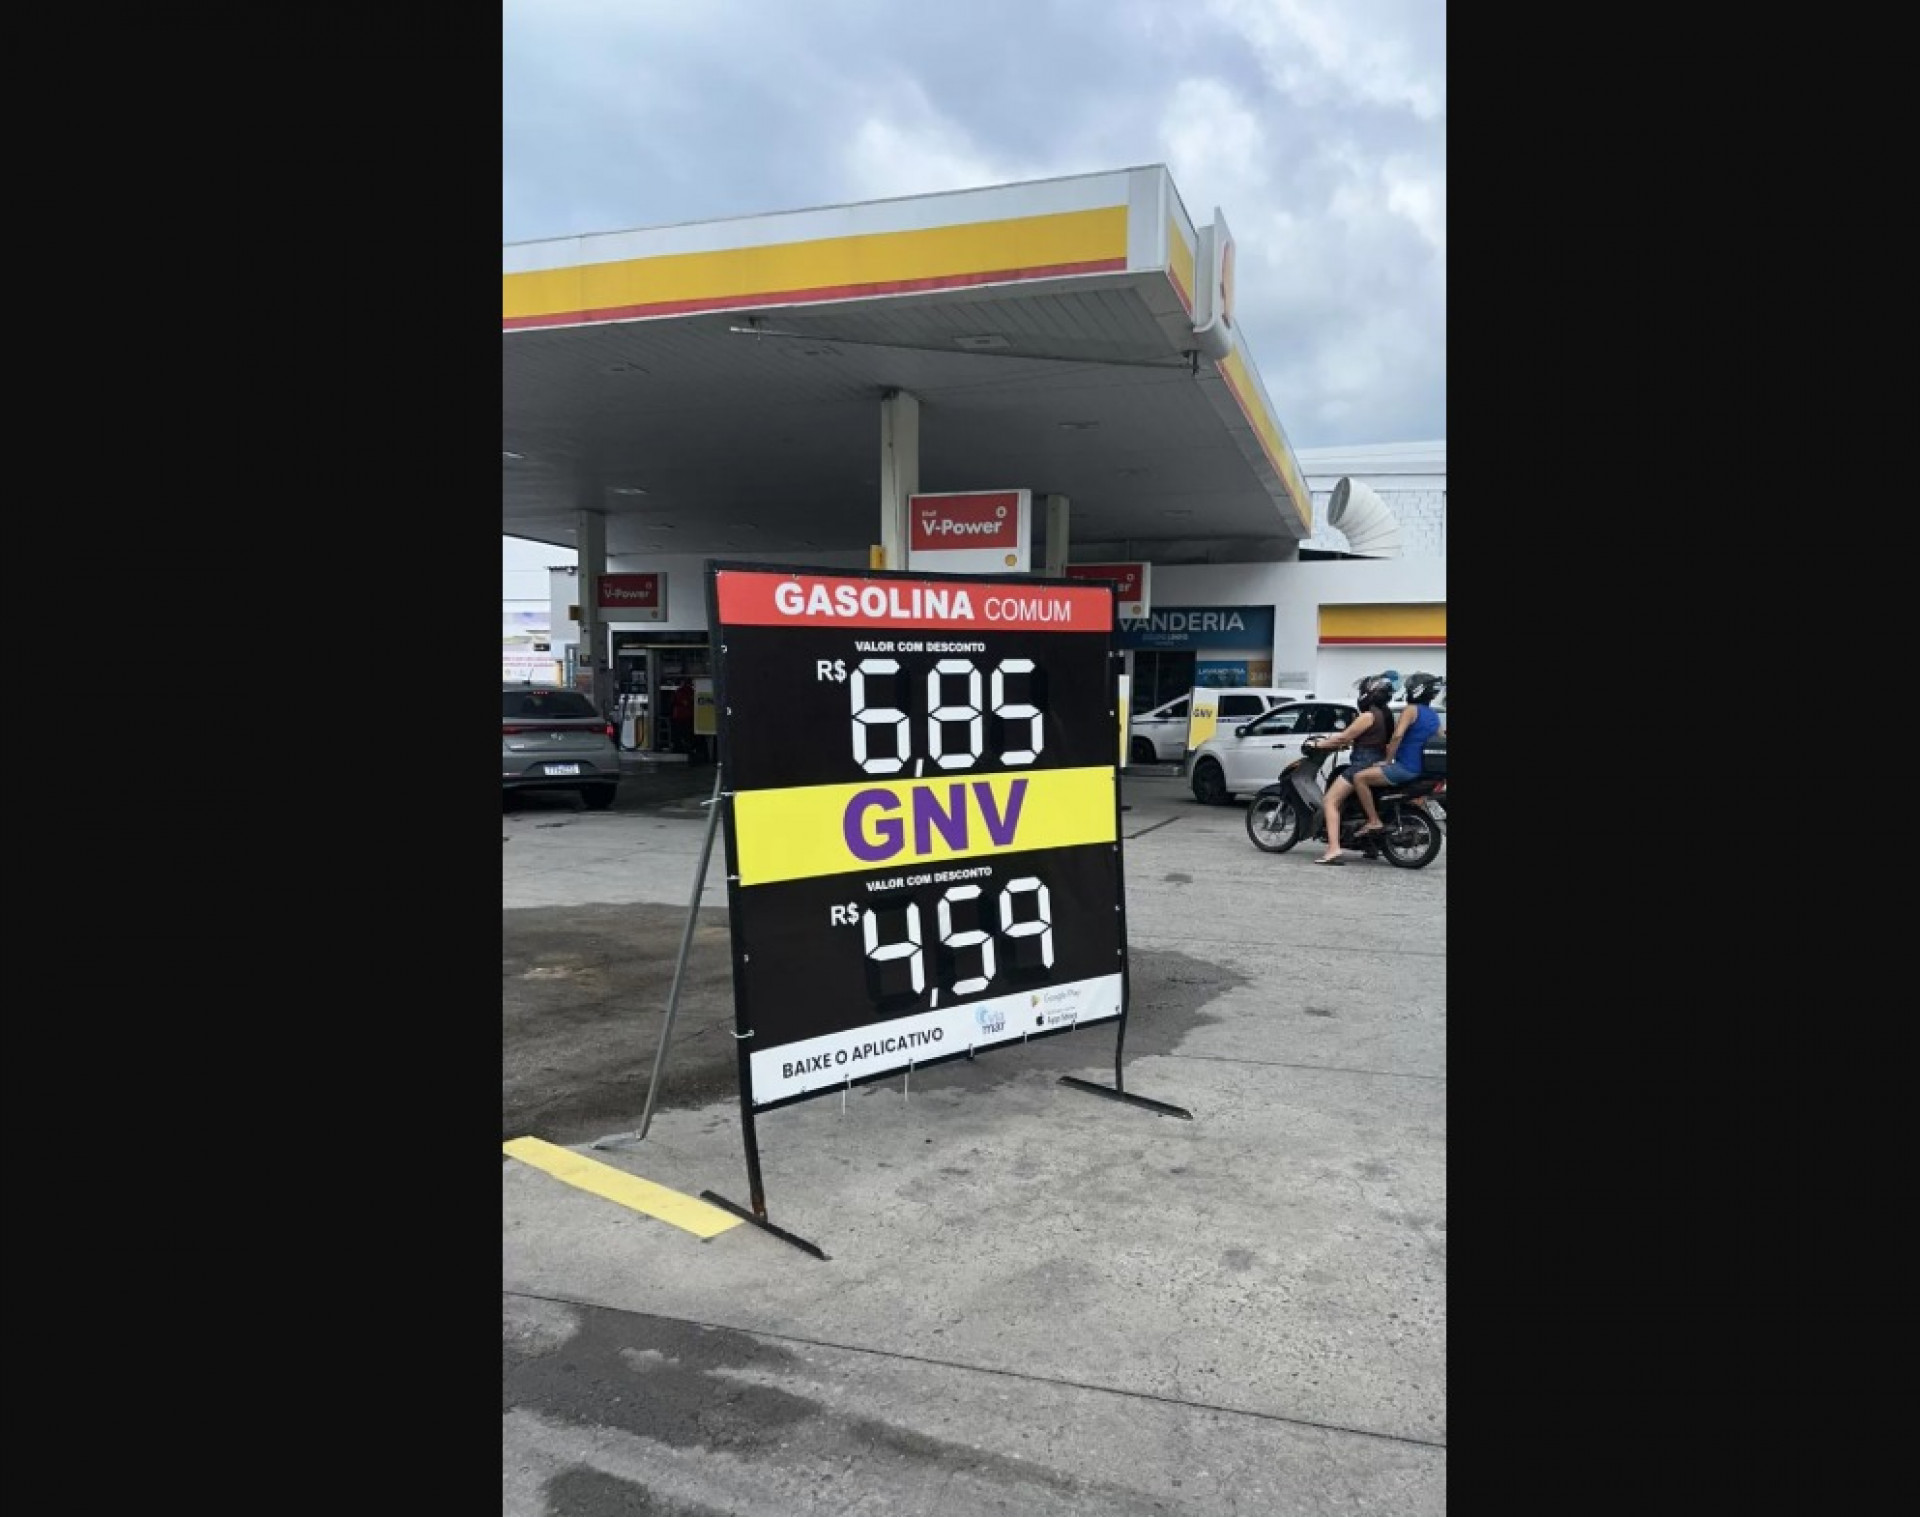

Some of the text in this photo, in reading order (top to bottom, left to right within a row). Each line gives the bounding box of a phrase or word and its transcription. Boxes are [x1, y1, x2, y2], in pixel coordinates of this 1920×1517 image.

[921, 519, 1003, 536] V-Power
[774, 582, 1072, 622] GASOLINA COMUM
[854, 641, 986, 652] VALOR COM DESCONTO
[816, 658, 1044, 778] R$ 6,85
[843, 778, 1029, 862] GNV
[866, 866, 993, 892] VALOR COM DESCONTO
[830, 876, 1054, 1008] R$ 4,59
[981, 1019, 1006, 1035] mar
[782, 1027, 945, 1079] BAIXE O APLICATIVO
